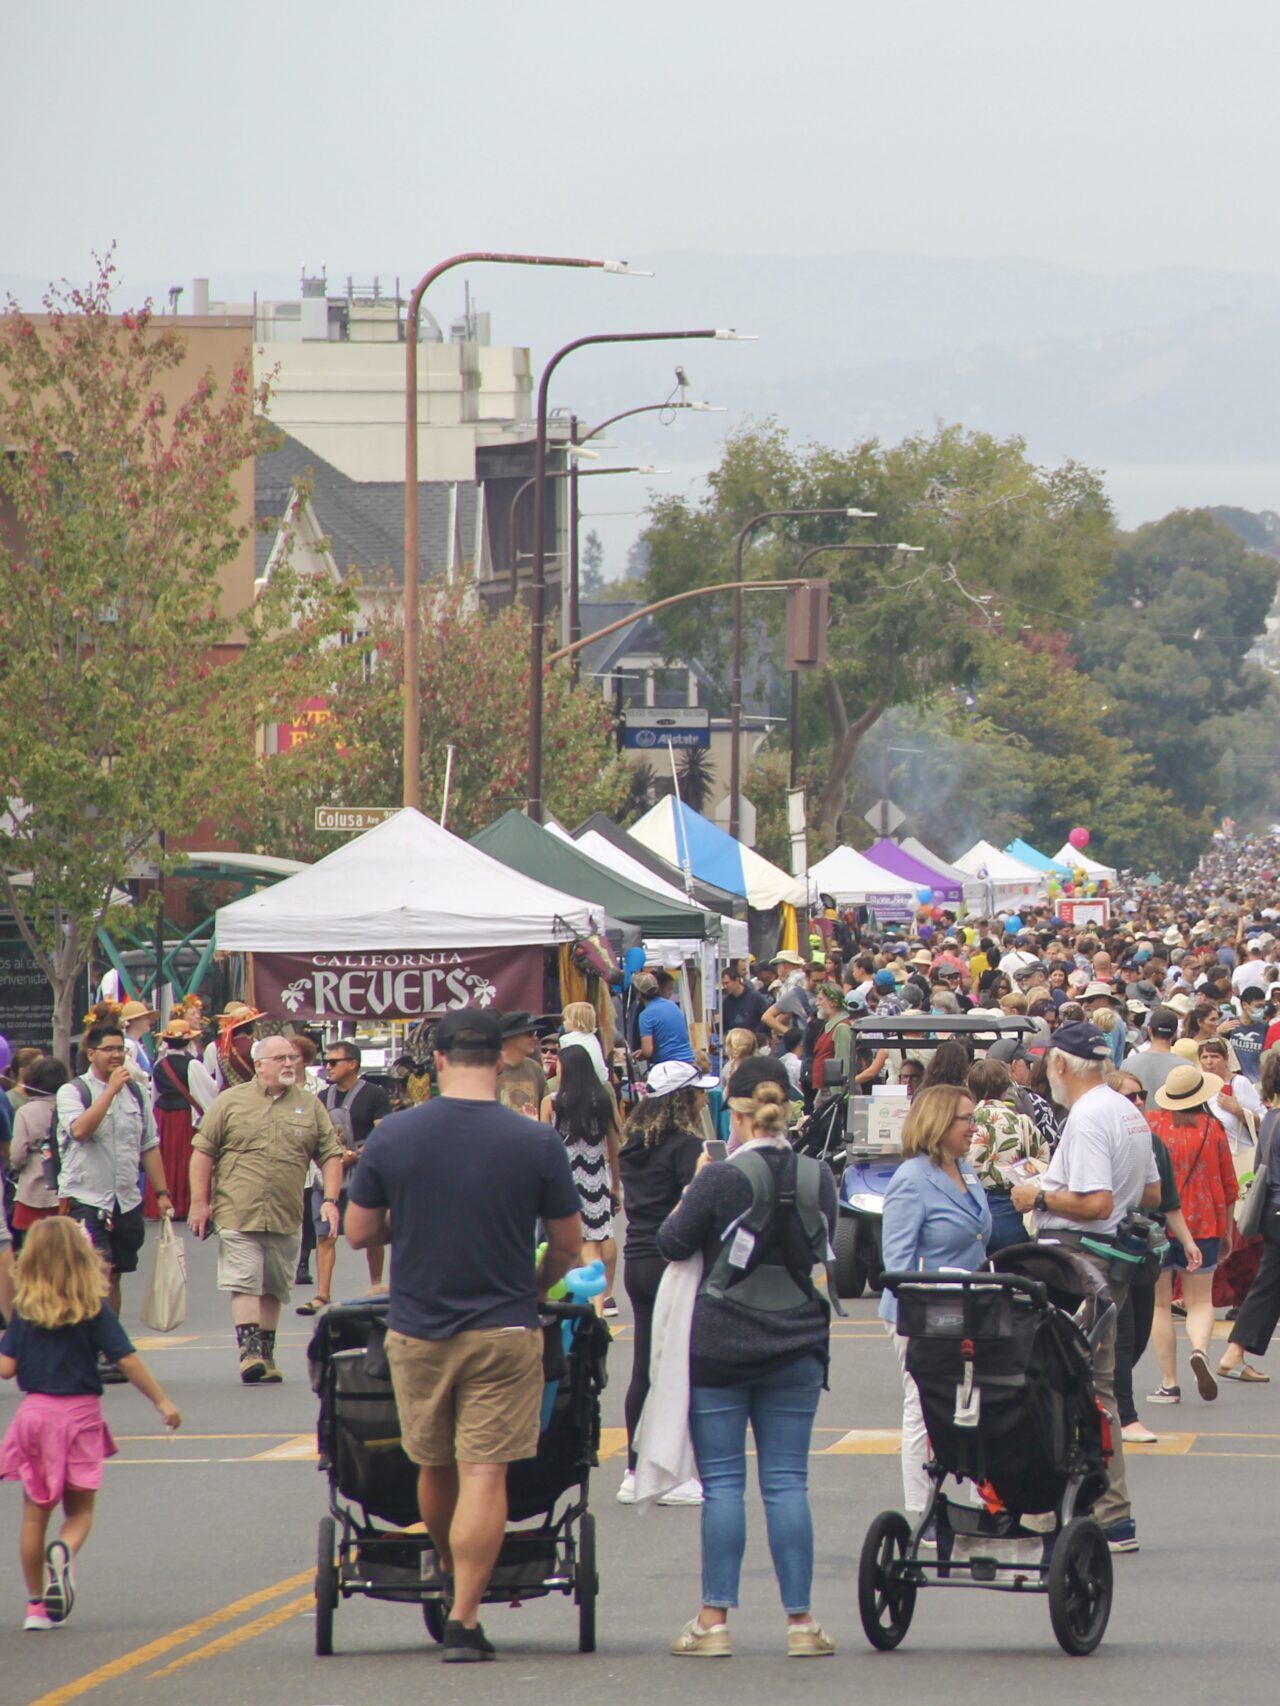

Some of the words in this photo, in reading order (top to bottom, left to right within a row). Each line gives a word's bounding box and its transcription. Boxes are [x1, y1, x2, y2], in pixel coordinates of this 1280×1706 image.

[656, 733, 700, 745] Allstate
[318, 810, 363, 827] Colusa
[366, 815, 380, 825] Ave
[312, 952, 464, 967] CALIFORNIA
[311, 967, 469, 1015] REVELS
